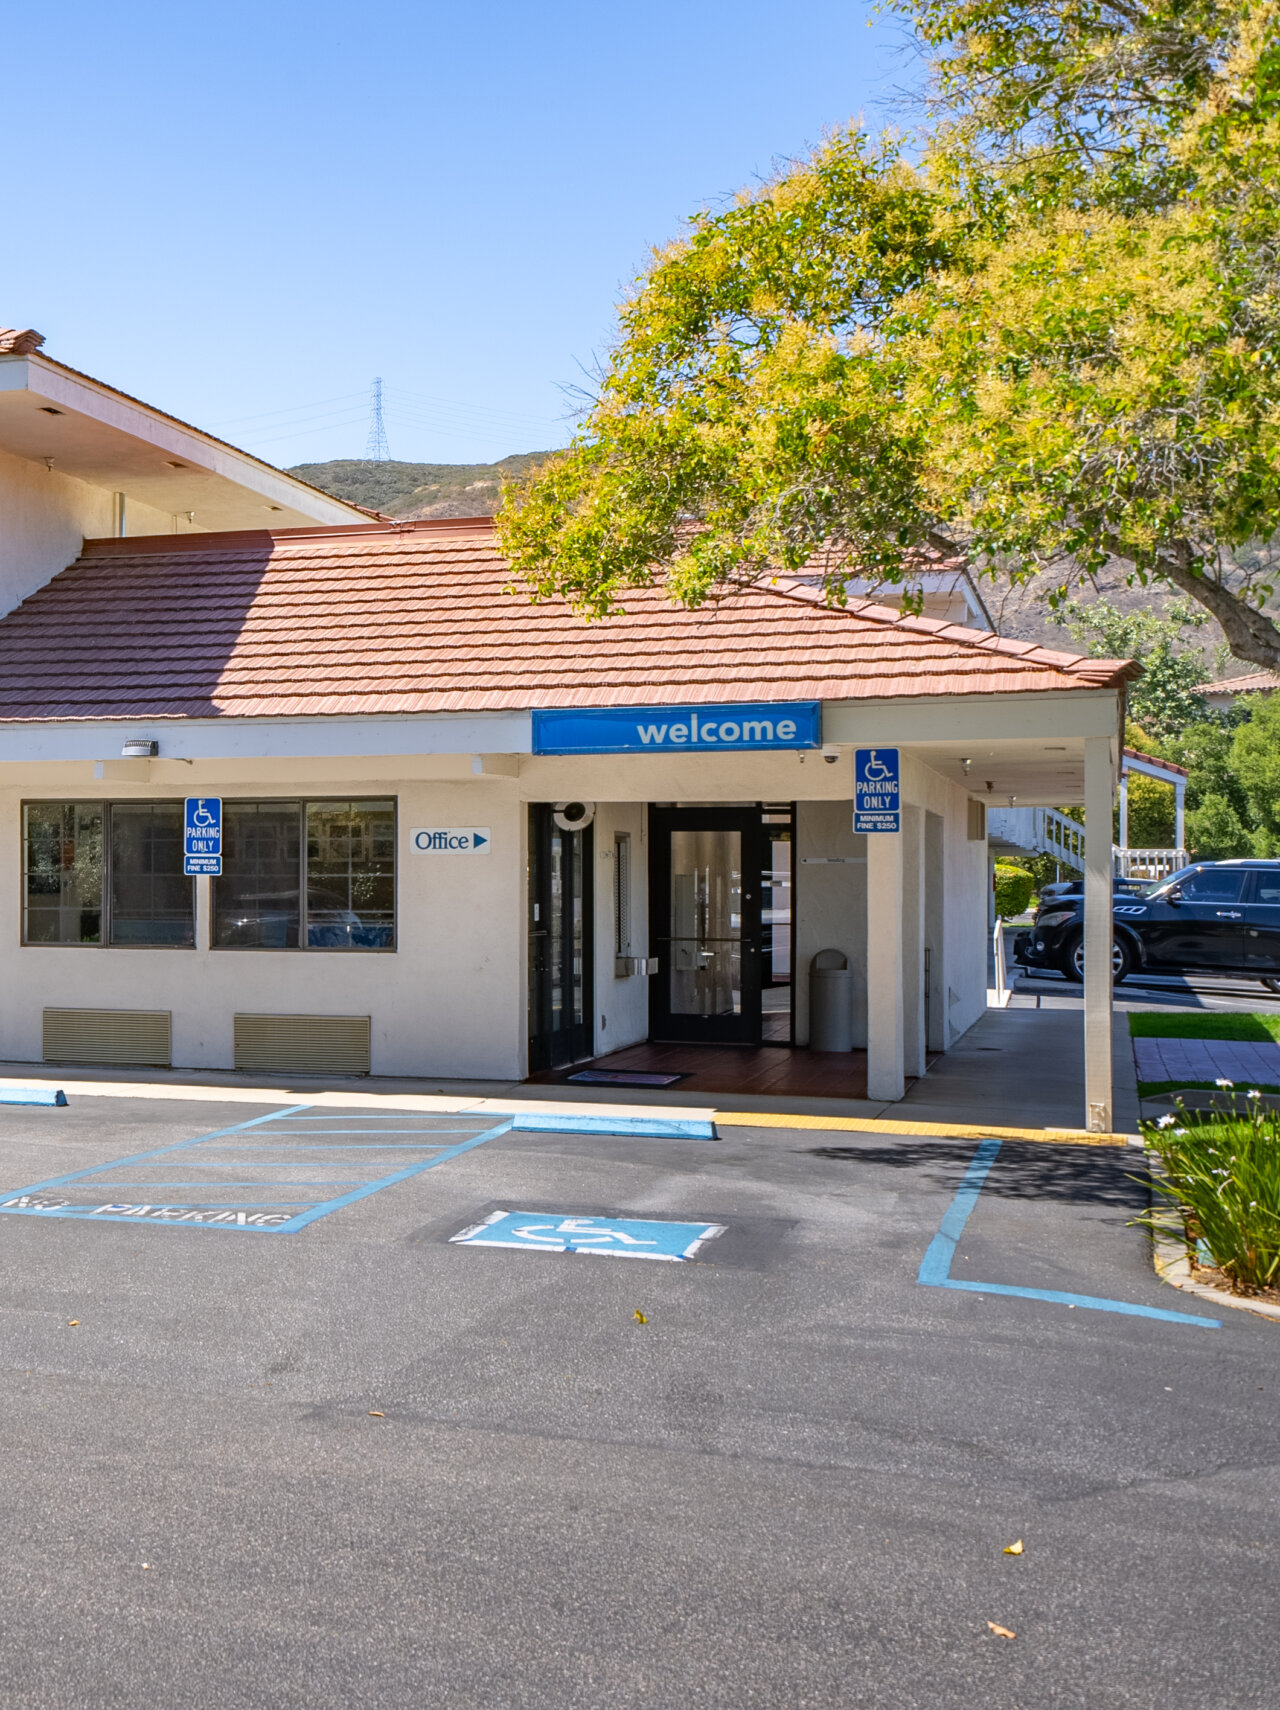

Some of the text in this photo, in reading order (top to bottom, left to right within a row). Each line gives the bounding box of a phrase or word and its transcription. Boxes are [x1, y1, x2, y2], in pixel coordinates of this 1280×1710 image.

[636, 713, 797, 744] welcome
[856, 781, 898, 794] PARKING
[863, 796, 891, 808] ONLY
[187, 827, 220, 838] PARKING
[192, 840, 214, 852] ONLY
[415, 831, 469, 850] Office
[90, 1203, 292, 1226] PARKING
